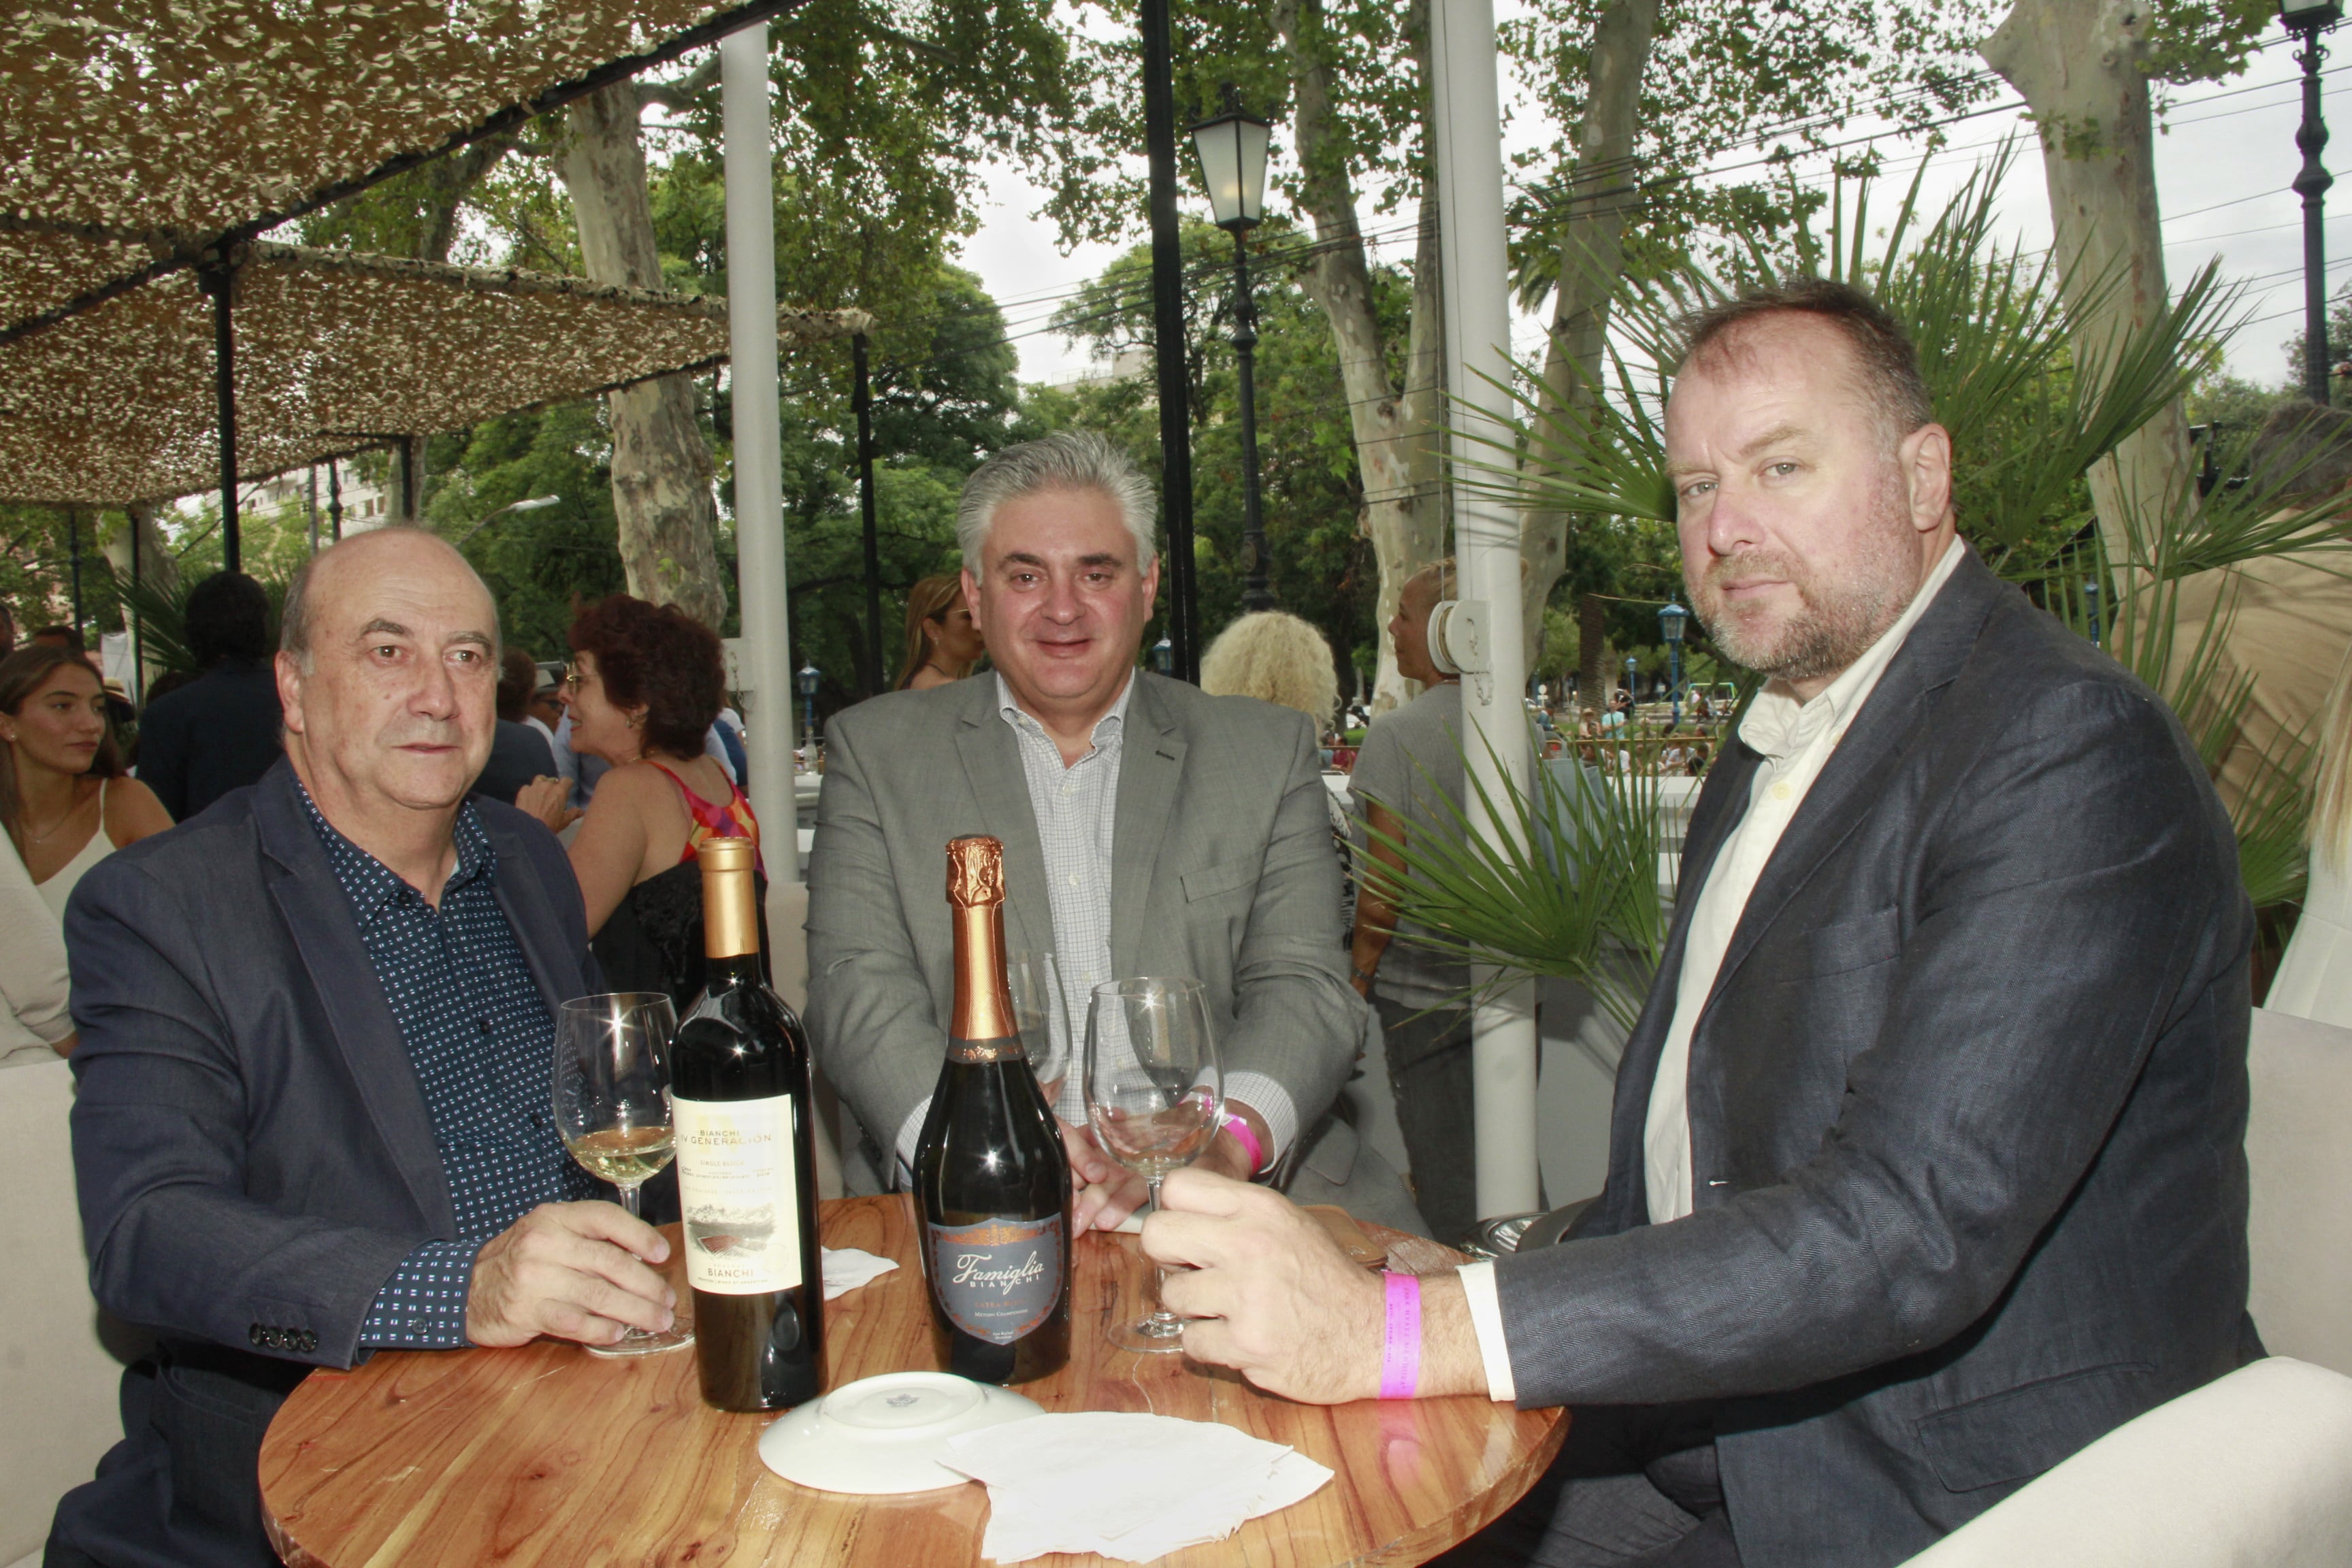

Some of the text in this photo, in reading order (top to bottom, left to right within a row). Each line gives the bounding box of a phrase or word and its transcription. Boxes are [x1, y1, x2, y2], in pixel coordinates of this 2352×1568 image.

[681, 1133, 688, 1143] IV
[700, 1129, 740, 1137] BIANCHI
[708, 1268, 753, 1278] BIANCHI
[953, 1251, 1045, 1295] Famiglia
[970, 1274, 1040, 1288] BIANCHI
